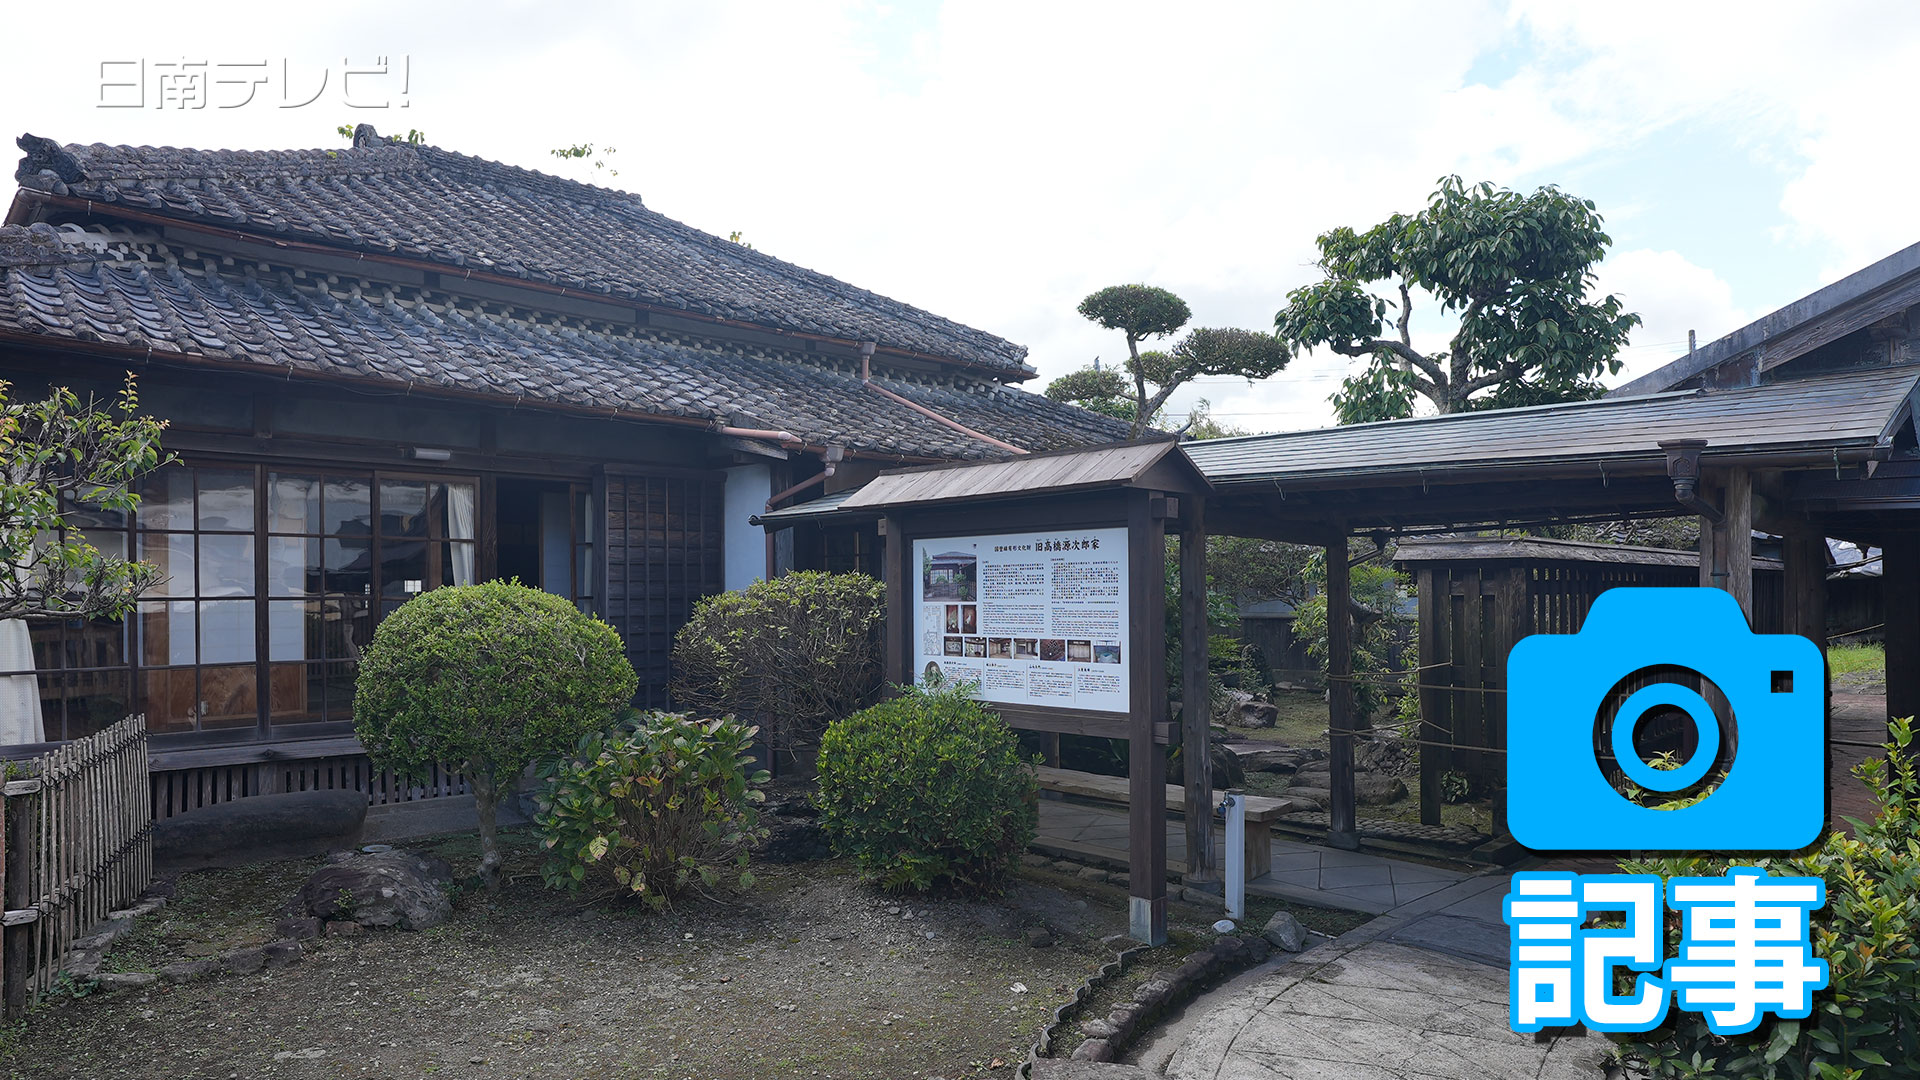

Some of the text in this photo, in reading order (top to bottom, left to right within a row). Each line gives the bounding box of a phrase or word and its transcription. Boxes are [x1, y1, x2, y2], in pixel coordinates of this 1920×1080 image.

[1035, 538, 1100, 552] 旧高橋源次郎家
